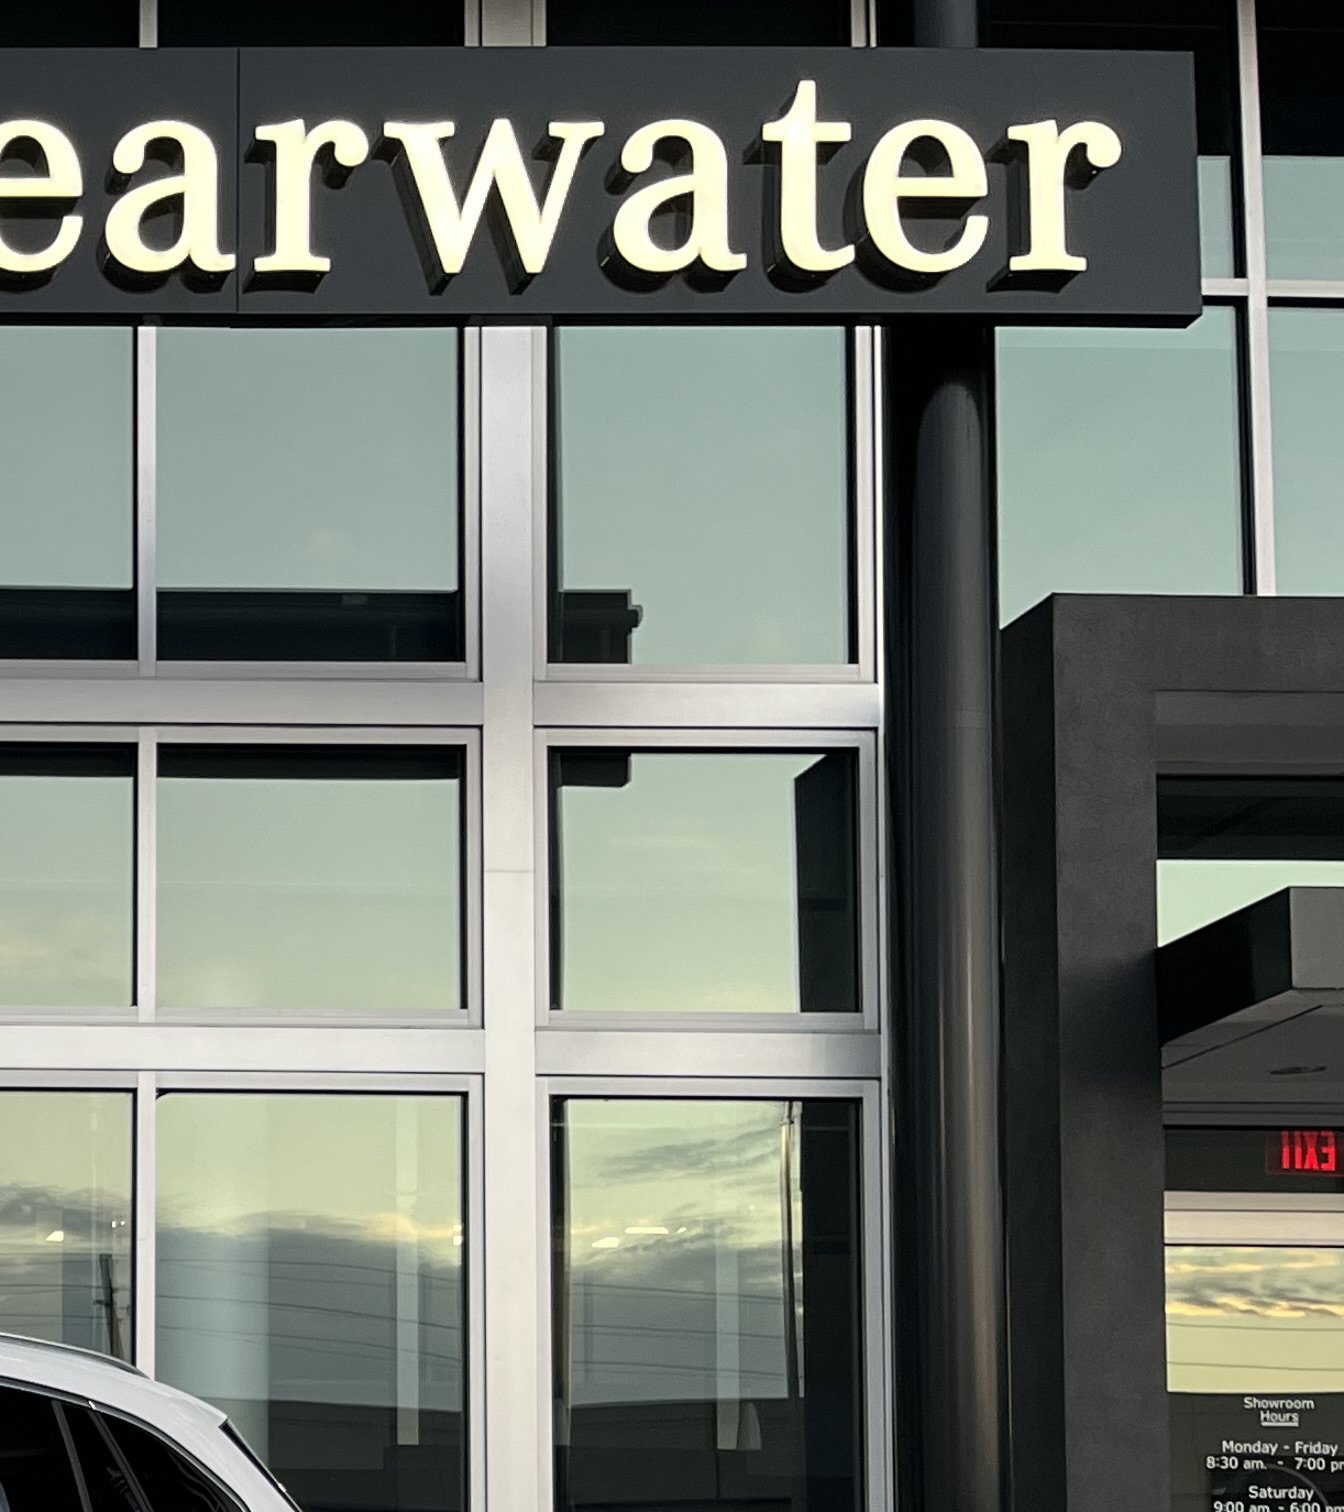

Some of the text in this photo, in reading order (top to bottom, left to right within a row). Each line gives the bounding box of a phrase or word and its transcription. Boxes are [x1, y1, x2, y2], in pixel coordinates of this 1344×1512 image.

[1243, 1396, 1315, 1409] Showroom
[1260, 1410, 1299, 1423] Hours
[1222, 1440, 1278, 1456] Monday
[1295, 1441, 1338, 1457] Friday
[1206, 1456, 1239, 1469] 8:30
[1294, 1457, 1326, 1470] 7:00
[1248, 1485, 1314, 1501] Saturday
